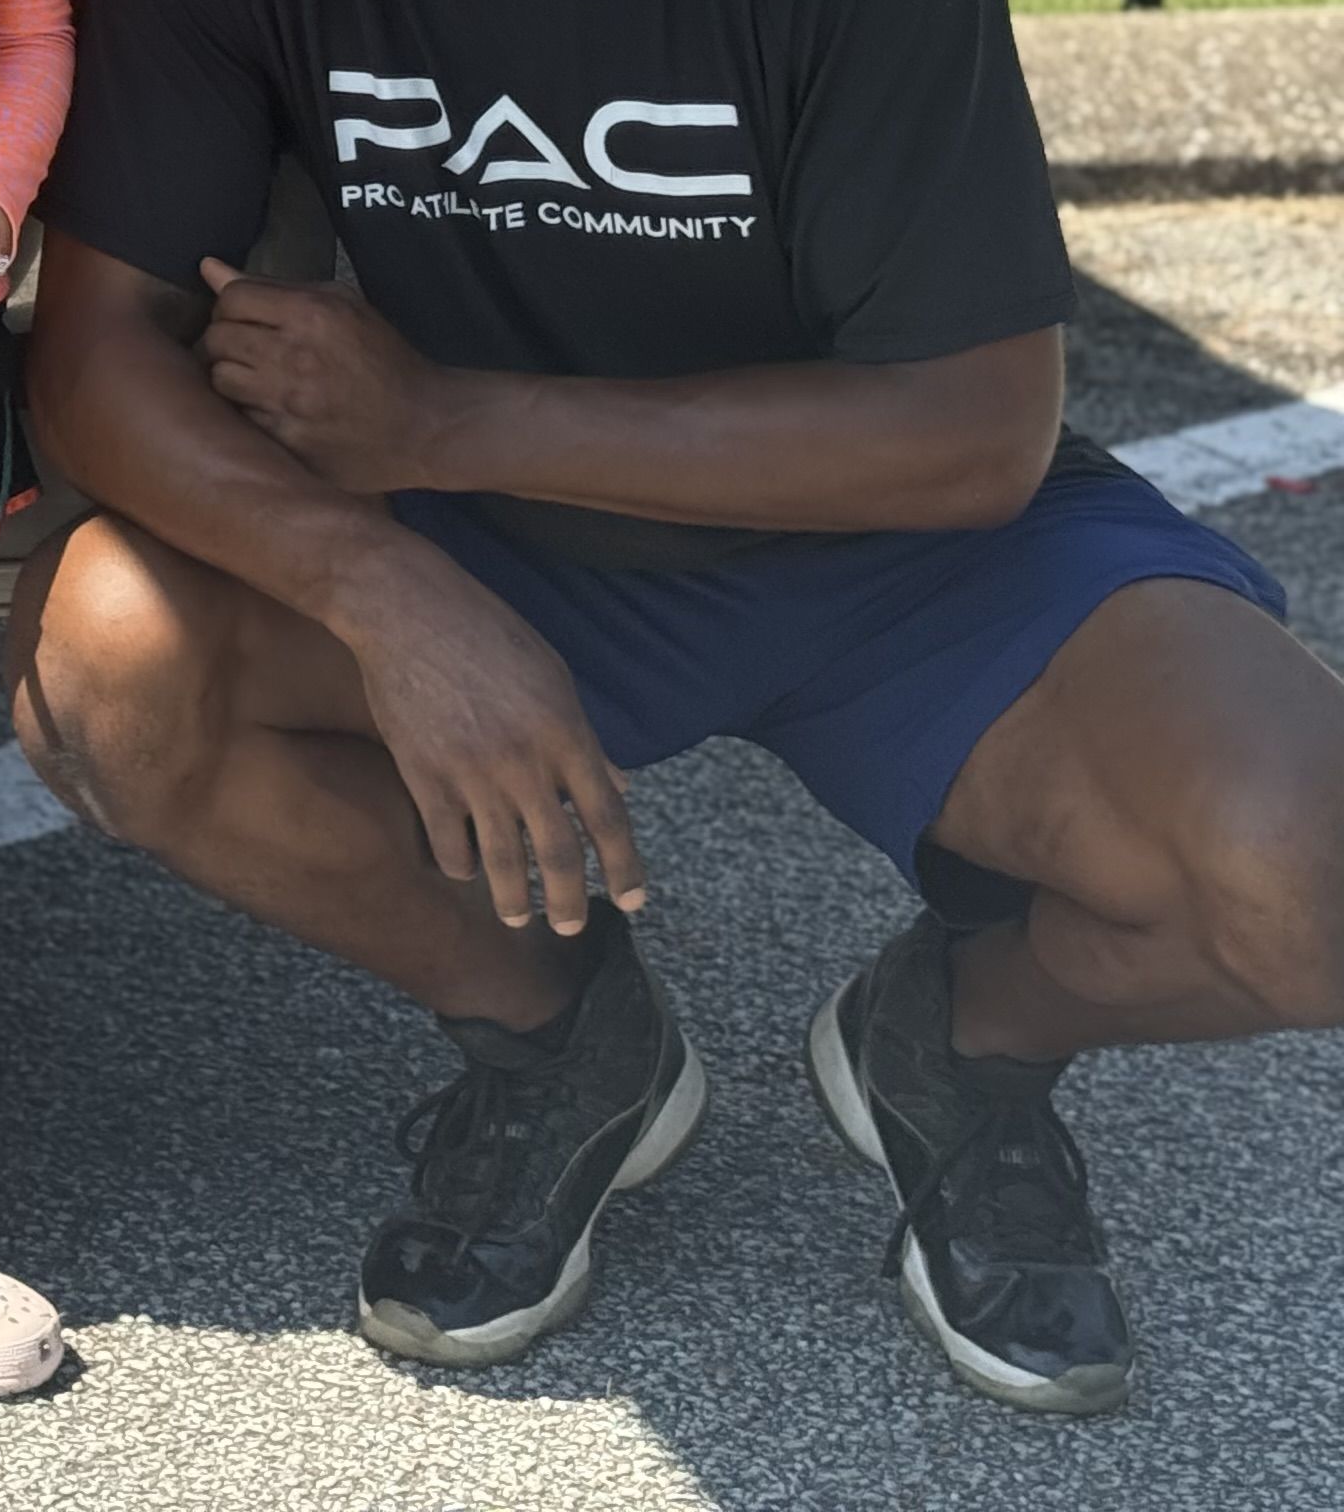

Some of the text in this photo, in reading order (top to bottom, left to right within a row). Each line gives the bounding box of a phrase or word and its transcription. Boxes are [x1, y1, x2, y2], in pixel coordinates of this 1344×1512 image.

[329, 70, 752, 197] PAC
[341, 183, 405, 208] PRO
[538, 201, 758, 239] COMMUNITY
